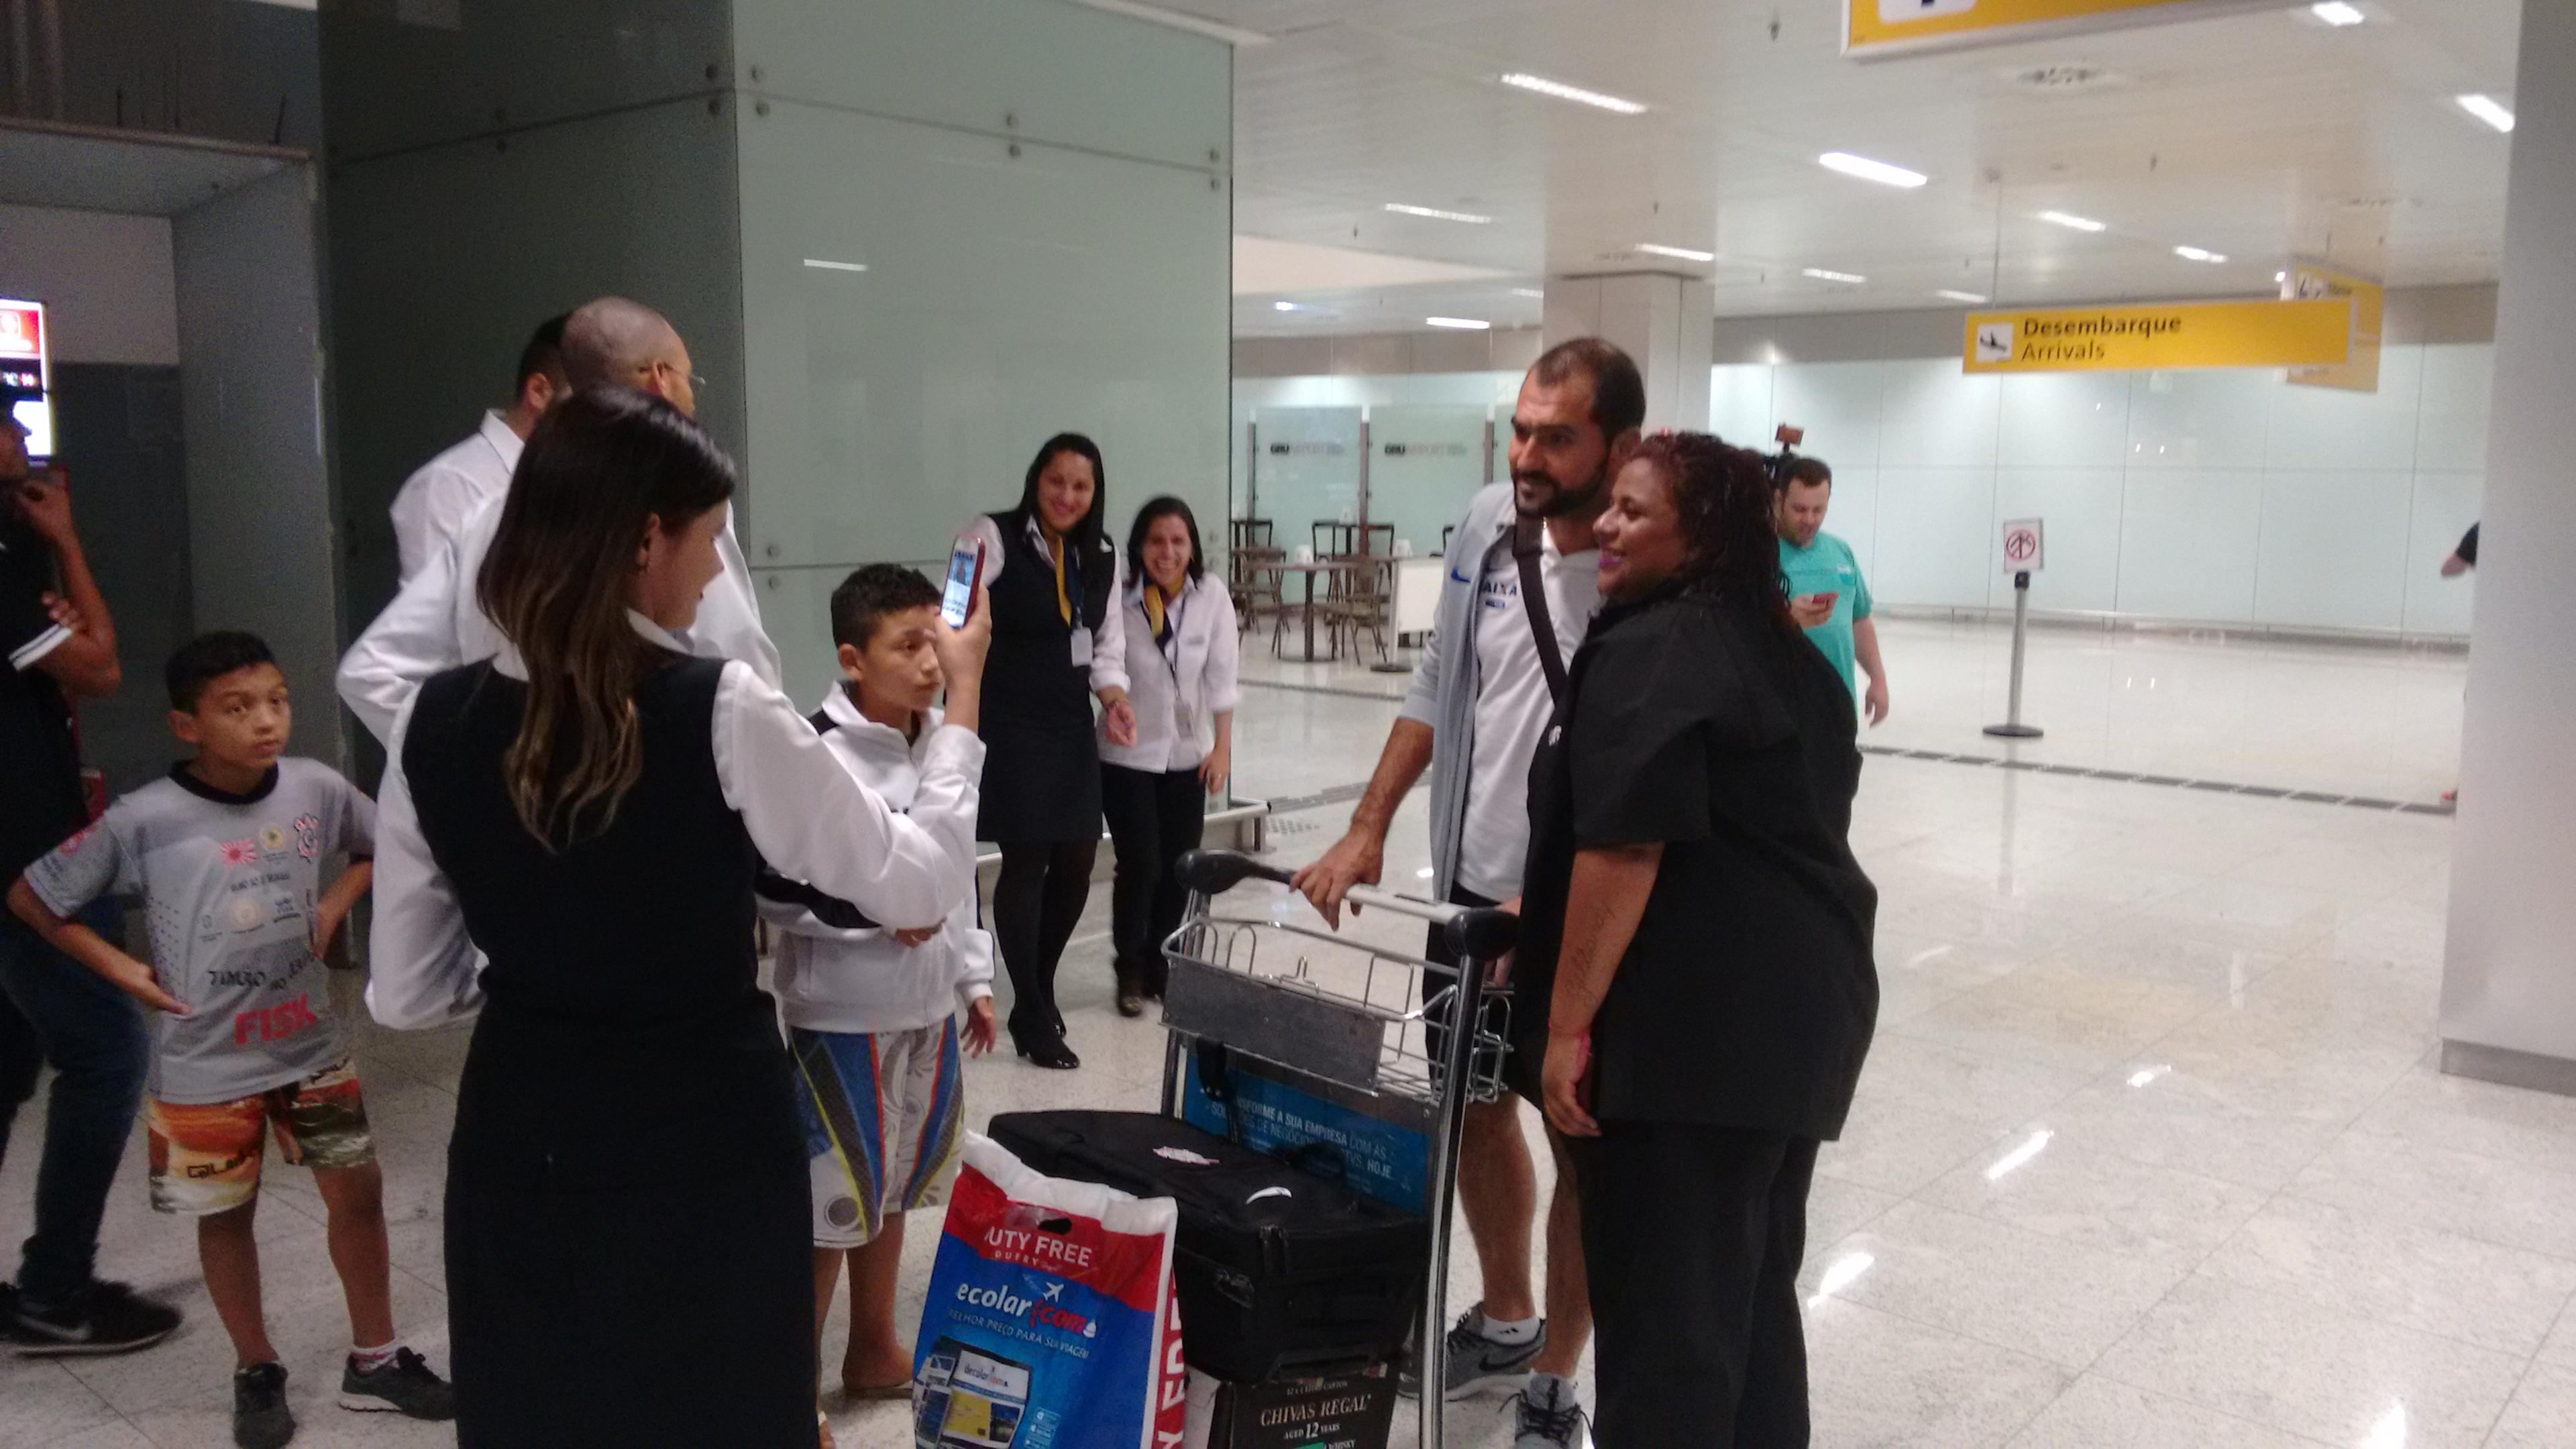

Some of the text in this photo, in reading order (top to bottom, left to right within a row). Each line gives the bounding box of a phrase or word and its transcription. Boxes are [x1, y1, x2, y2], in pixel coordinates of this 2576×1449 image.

[2023, 315, 2182, 339] Desembarque
[2021, 339, 2105, 362] Arrivals
[1483, 582, 1517, 596] AIXA
[235, 994, 317, 1044] FISK
[1285, 1113, 1303, 1130] SUA
[1305, 1120, 1347, 1146] EMPRESA
[1368, 1159, 1392, 1179] HOJE
[984, 1226, 1031, 1250] UTY
[1035, 1236, 1093, 1267] FREE
[995, 1250, 1038, 1266] DUFRY
[1016, 1329, 1042, 1345] PARA
[1260, 1395, 1366, 1427] CHIVAS REGAL
[1284, 1421, 1340, 1440] AGED 12 YEARS
